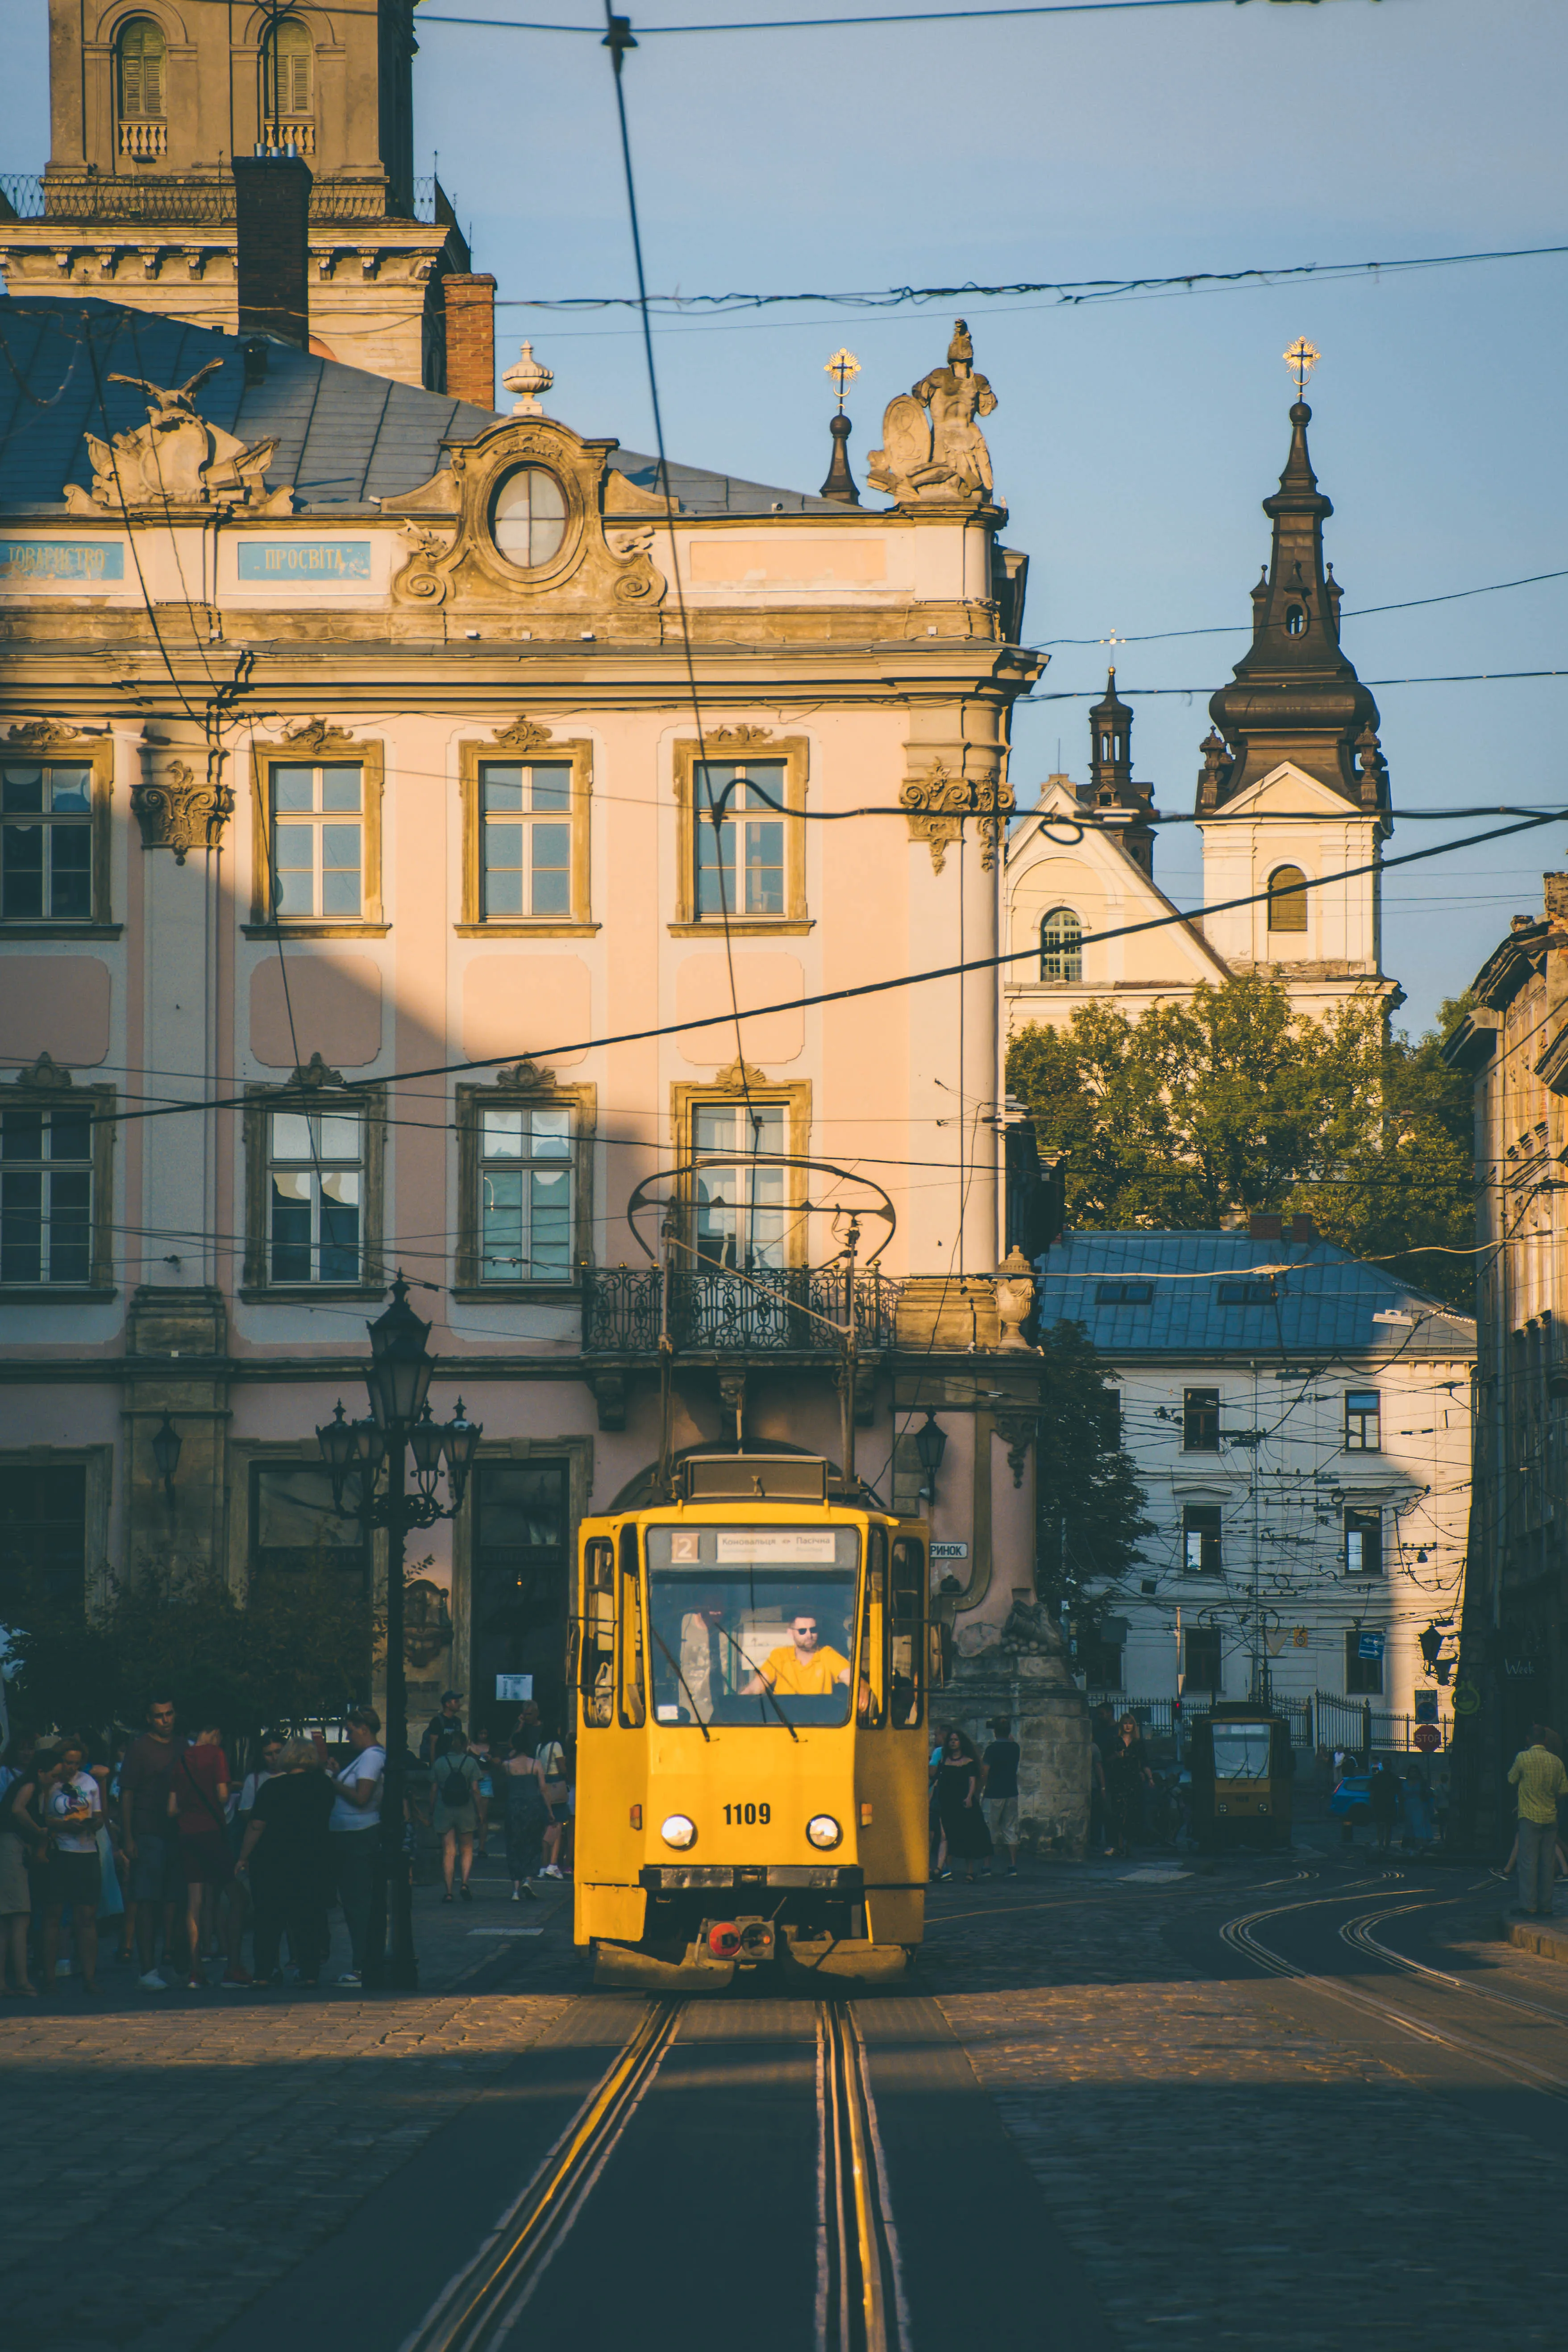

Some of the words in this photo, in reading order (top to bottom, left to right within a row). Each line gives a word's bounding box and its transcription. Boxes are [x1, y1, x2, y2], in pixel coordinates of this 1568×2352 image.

[796, 1536, 831, 1544] Пасічна
[678, 1537, 692, 1558] 2
[930, 1545, 962, 1556] РИНОК
[1505, 1658, 1535, 1675] Week
[1416, 1734, 1439, 1743] STOP
[723, 1803, 771, 1825] 1109
